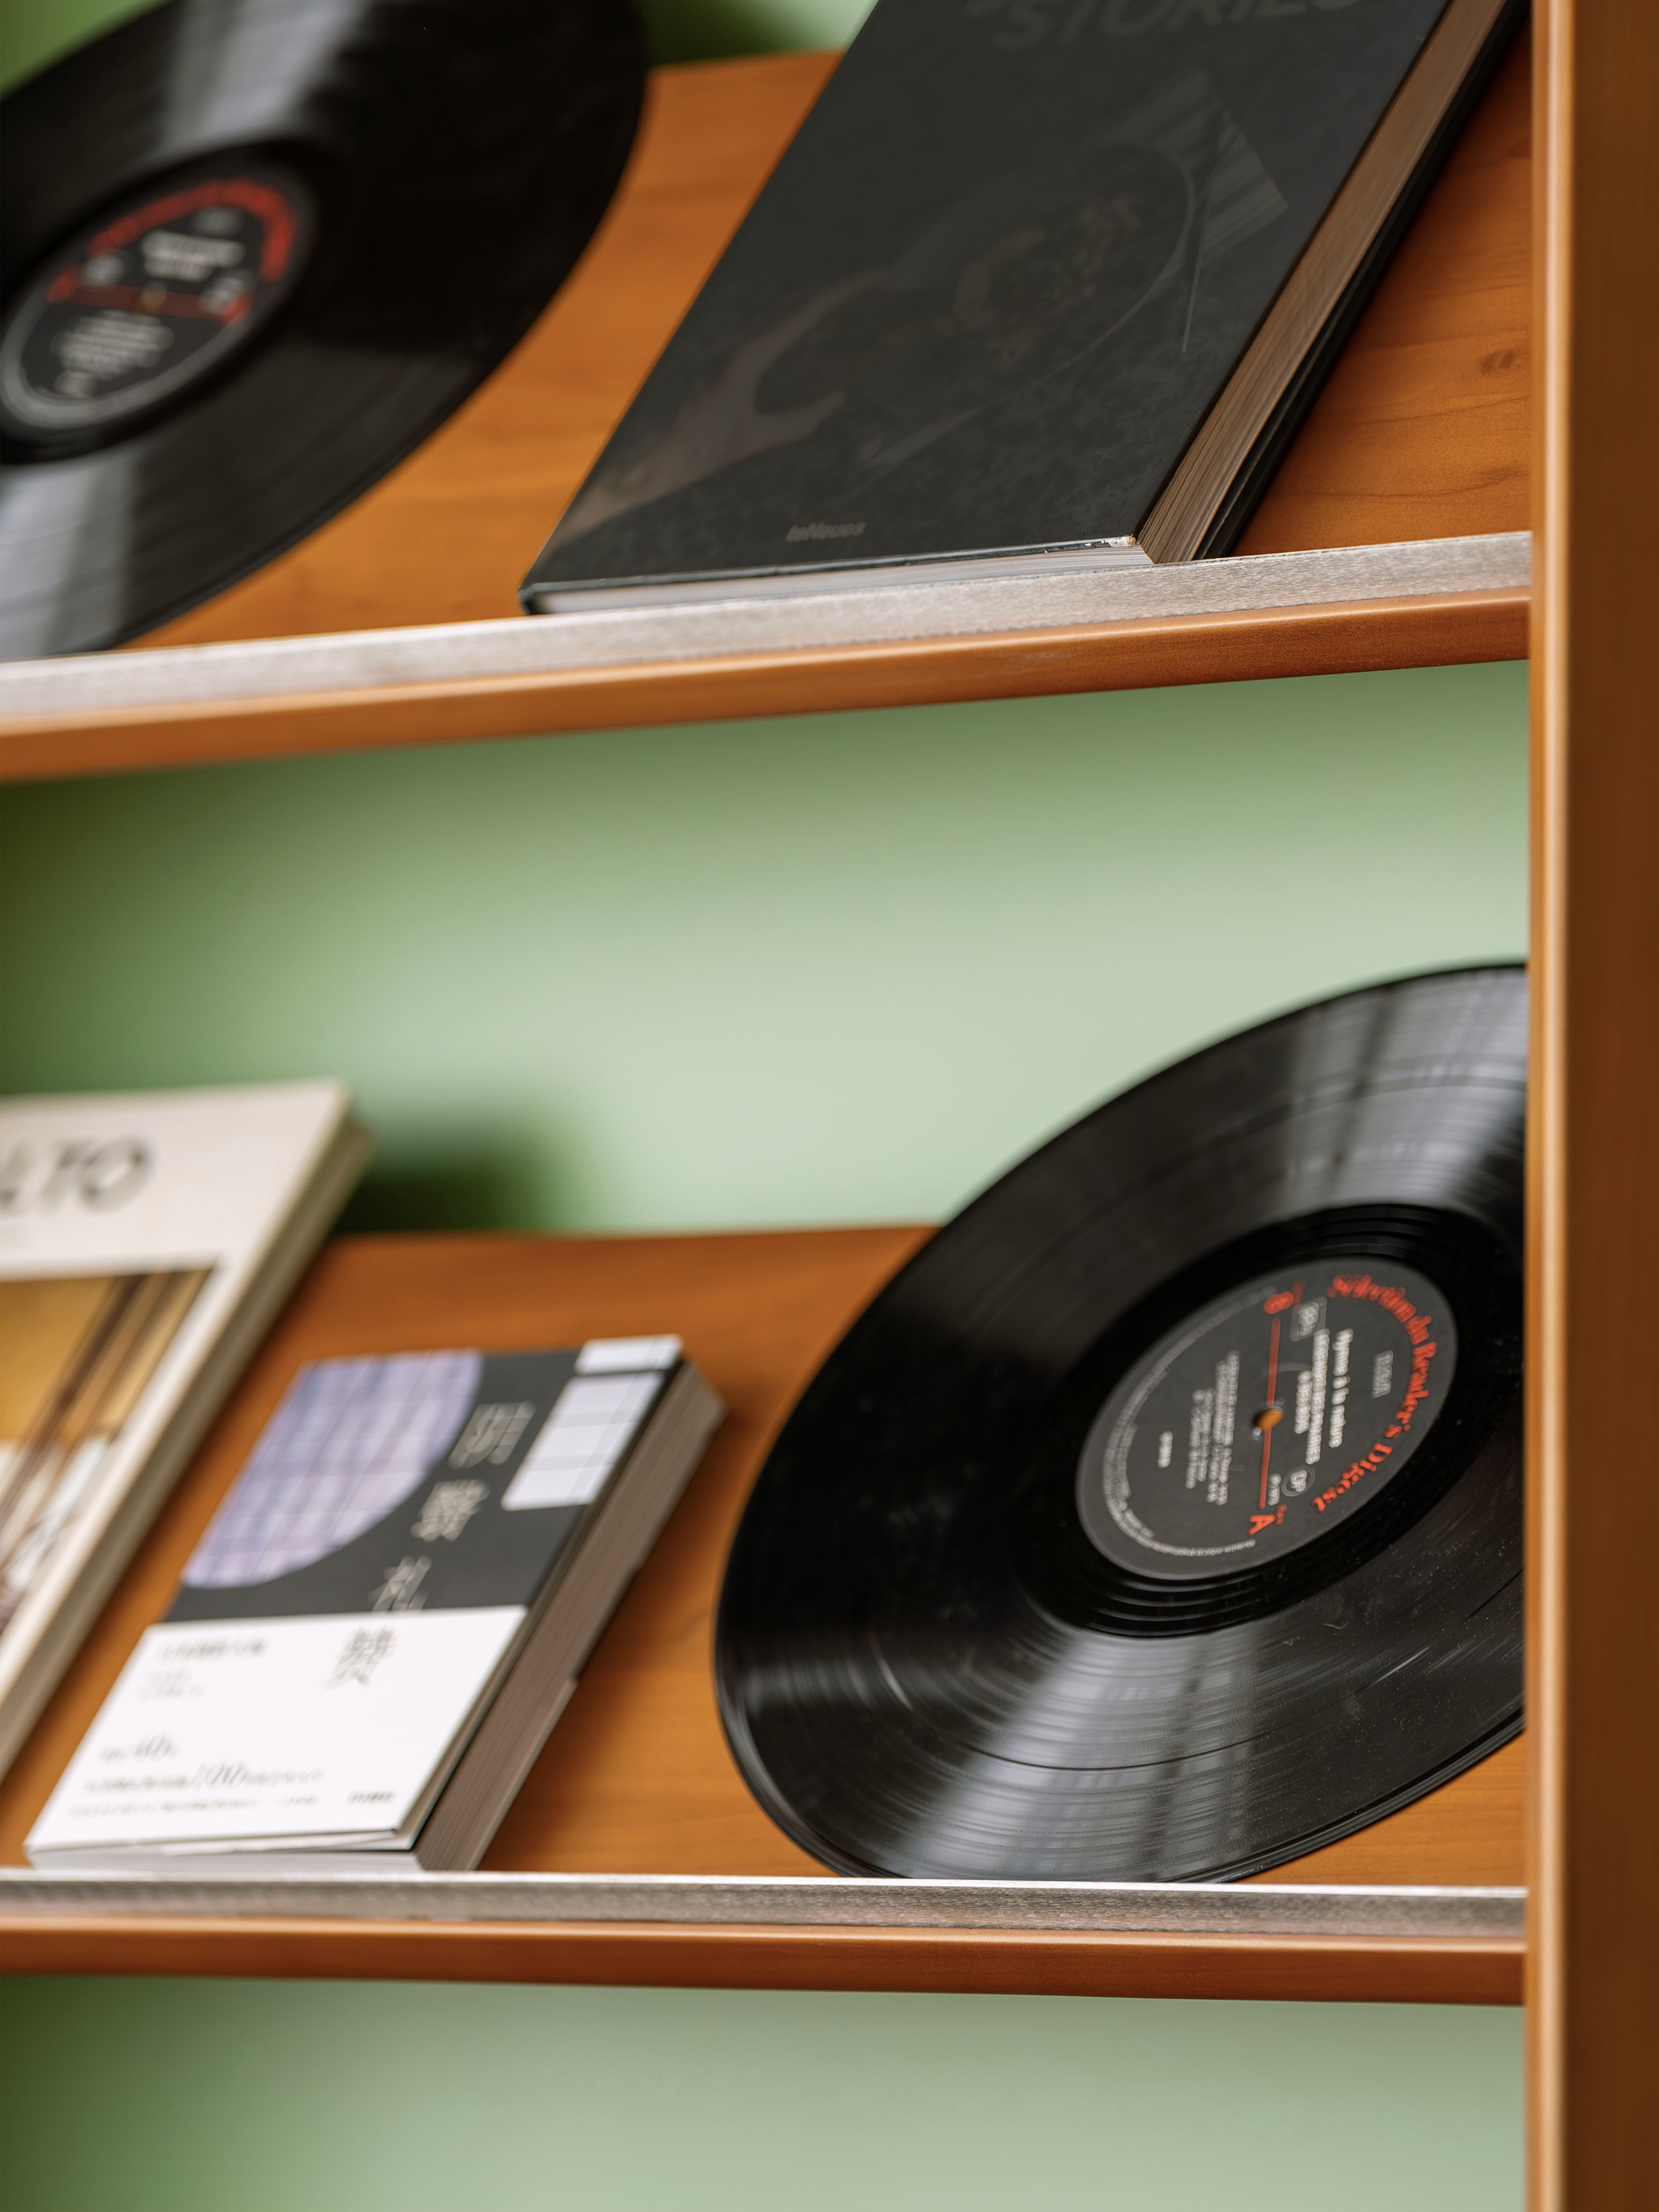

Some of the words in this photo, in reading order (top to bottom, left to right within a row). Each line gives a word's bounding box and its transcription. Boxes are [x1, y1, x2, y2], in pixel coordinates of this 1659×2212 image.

[1405, 1315, 1432, 1345] du
[1331, 1387, 1349, 1405] la
[1385, 1341, 1437, 1438] Reader's
[1328, 1405, 1346, 1448] nature
[1312, 1443, 1392, 1512] Digest
[1248, 1514, 1276, 1535] A
